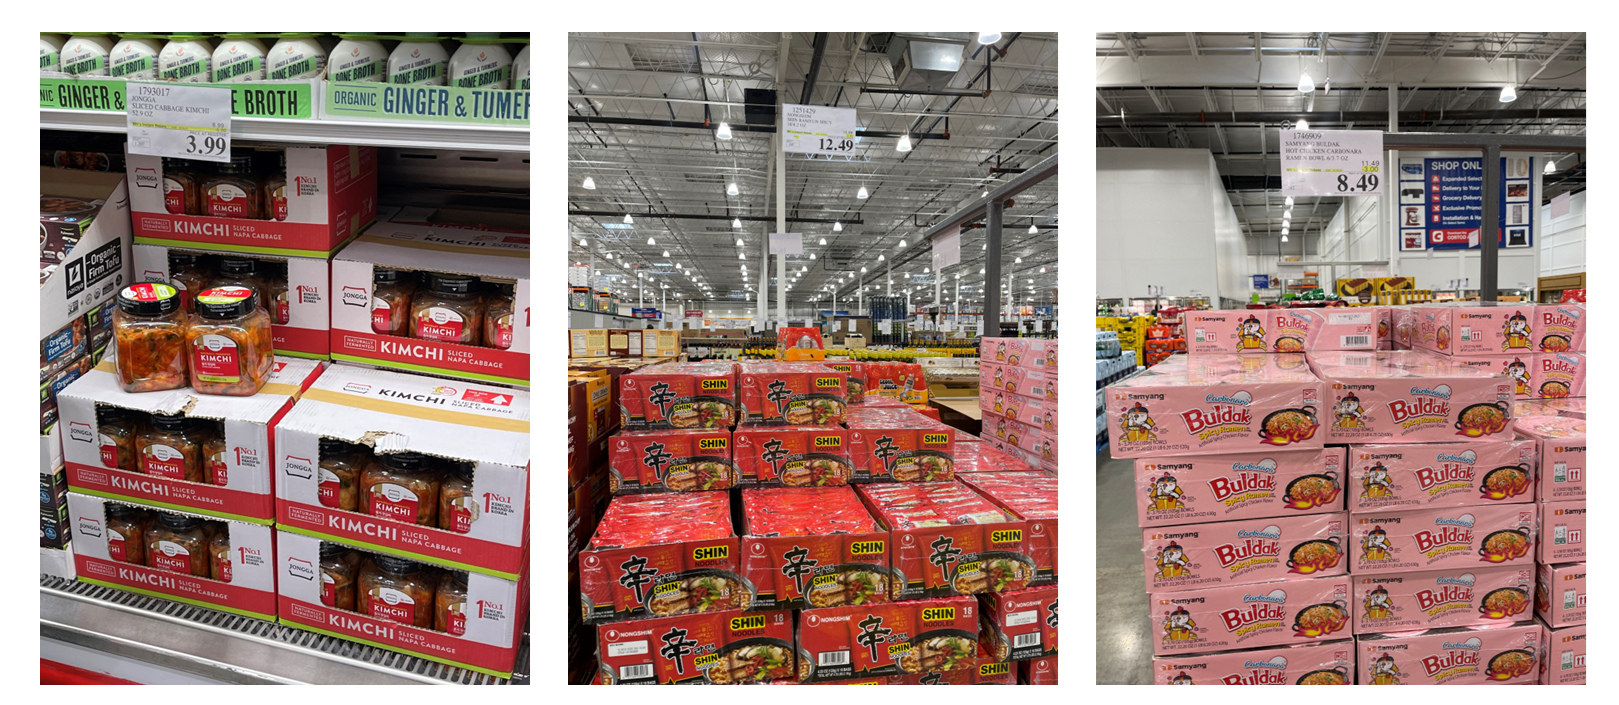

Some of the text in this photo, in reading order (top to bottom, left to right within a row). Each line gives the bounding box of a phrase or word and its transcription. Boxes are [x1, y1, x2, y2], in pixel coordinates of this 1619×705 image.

[233, 60, 254, 77] BROTH
[288, 59, 310, 77] BROTH
[412, 64, 437, 82] BROTH
[478, 68, 503, 86] BROTH
[58, 84, 111, 110] GINGER
[113, 91, 125, 111] &
[138, 86, 170, 97] 1793017
[131, 95, 156, 103] JONGGA
[245, 89, 297, 116] BROTH
[334, 90, 377, 107] ORGANIC
[383, 86, 449, 117] GINGER
[455, 95, 468, 117] &
[154, 104, 184, 113] CABBAGE
[185, 106, 210, 114] KIMCHI
[792, 106, 816, 115] 1251429
[1293, 132, 1322, 140] 1746909
[186, 135, 227, 156] 3.99
[818, 138, 854, 152] 12.49
[1431, 161, 1459, 170] SHOP
[136, 174, 157, 182] JONGGA
[1337, 173, 1380, 193] 8.49
[1442, 185, 1463, 193] Delivery
[173, 220, 230, 237] KIMCHI
[233, 230, 282, 241] NAPA CABBAGE
[91, 245, 117, 265] Organic
[89, 255, 120, 279] Firm Tofu
[342, 292, 368, 301] JONGGA
[1202, 316, 1226, 324] Samyang
[1468, 313, 1492, 322] Samyang
[1542, 313, 1577, 330] Buldak
[423, 326, 456, 337] KIMCHI
[346, 337, 374, 346] NATURALLY
[346, 341, 375, 351] FERMENTED
[380, 340, 443, 361] KIMCHI
[447, 350, 473, 358] SLICED
[200, 354, 233, 363] KIMCHI
[447, 356, 504, 369] NAPA CABBAGE
[703, 380, 728, 389] SHIN
[1342, 383, 1375, 392] Samyang
[378, 388, 446, 405] KIMCHI
[1128, 393, 1165, 402] Samyang
[1410, 386, 1450, 400] Carbonara
[1205, 393, 1250, 408] Carbonara
[476, 406, 513, 414] CABBAGE
[1387, 397, 1451, 424] Buldak
[1180, 404, 1252, 435] Buldak
[1401, 415, 1444, 429] Spicy Ramen
[1198, 428, 1219, 441] Spicy
[1219, 424, 1246, 436] Ramen
[286, 461, 312, 473] JONGGA
[1414, 462, 1476, 490] Buldak
[110, 475, 169, 497] KIMCHI
[1207, 471, 1277, 502] Buldak
[490, 492, 511, 504] No.1
[291, 507, 321, 518] NATURALLY
[375, 502, 411, 517] KIMCHI
[291, 512, 322, 524] FERMENTED
[328, 514, 397, 541] KIMCHI
[401, 530, 429, 541] SLICED
[992, 531, 1022, 542] SHIN
[401, 536, 462, 555] NAPA CABBAGE
[851, 541, 884, 554] SHIN
[992, 542, 1022, 550] NOODLES
[695, 546, 728, 560] SHIN
[851, 554, 884, 562] NOODLES
[930, 535, 963, 583] 辛
[288, 563, 314, 575] JONGGA
[694, 559, 729, 568] NOODLES
[119, 567, 176, 590] KIMCHI
[619, 555, 659, 604] 辛
[655, 582, 680, 595] SHIN
[720, 588, 730, 597] 18
[1016, 601, 1042, 609] NONGSHIM
[773, 613, 784, 623] 18
[820, 614, 851, 624] NONGSHIM
[922, 606, 955, 621] SHIN
[329, 613, 394, 640] KIMCHI
[730, 615, 766, 631] SHIN
[922, 620, 955, 629] NOODLES
[620, 629, 653, 638] NONGSHIM
[731, 629, 766, 638] NOODLES
[660, 627, 699, 675] 辛
